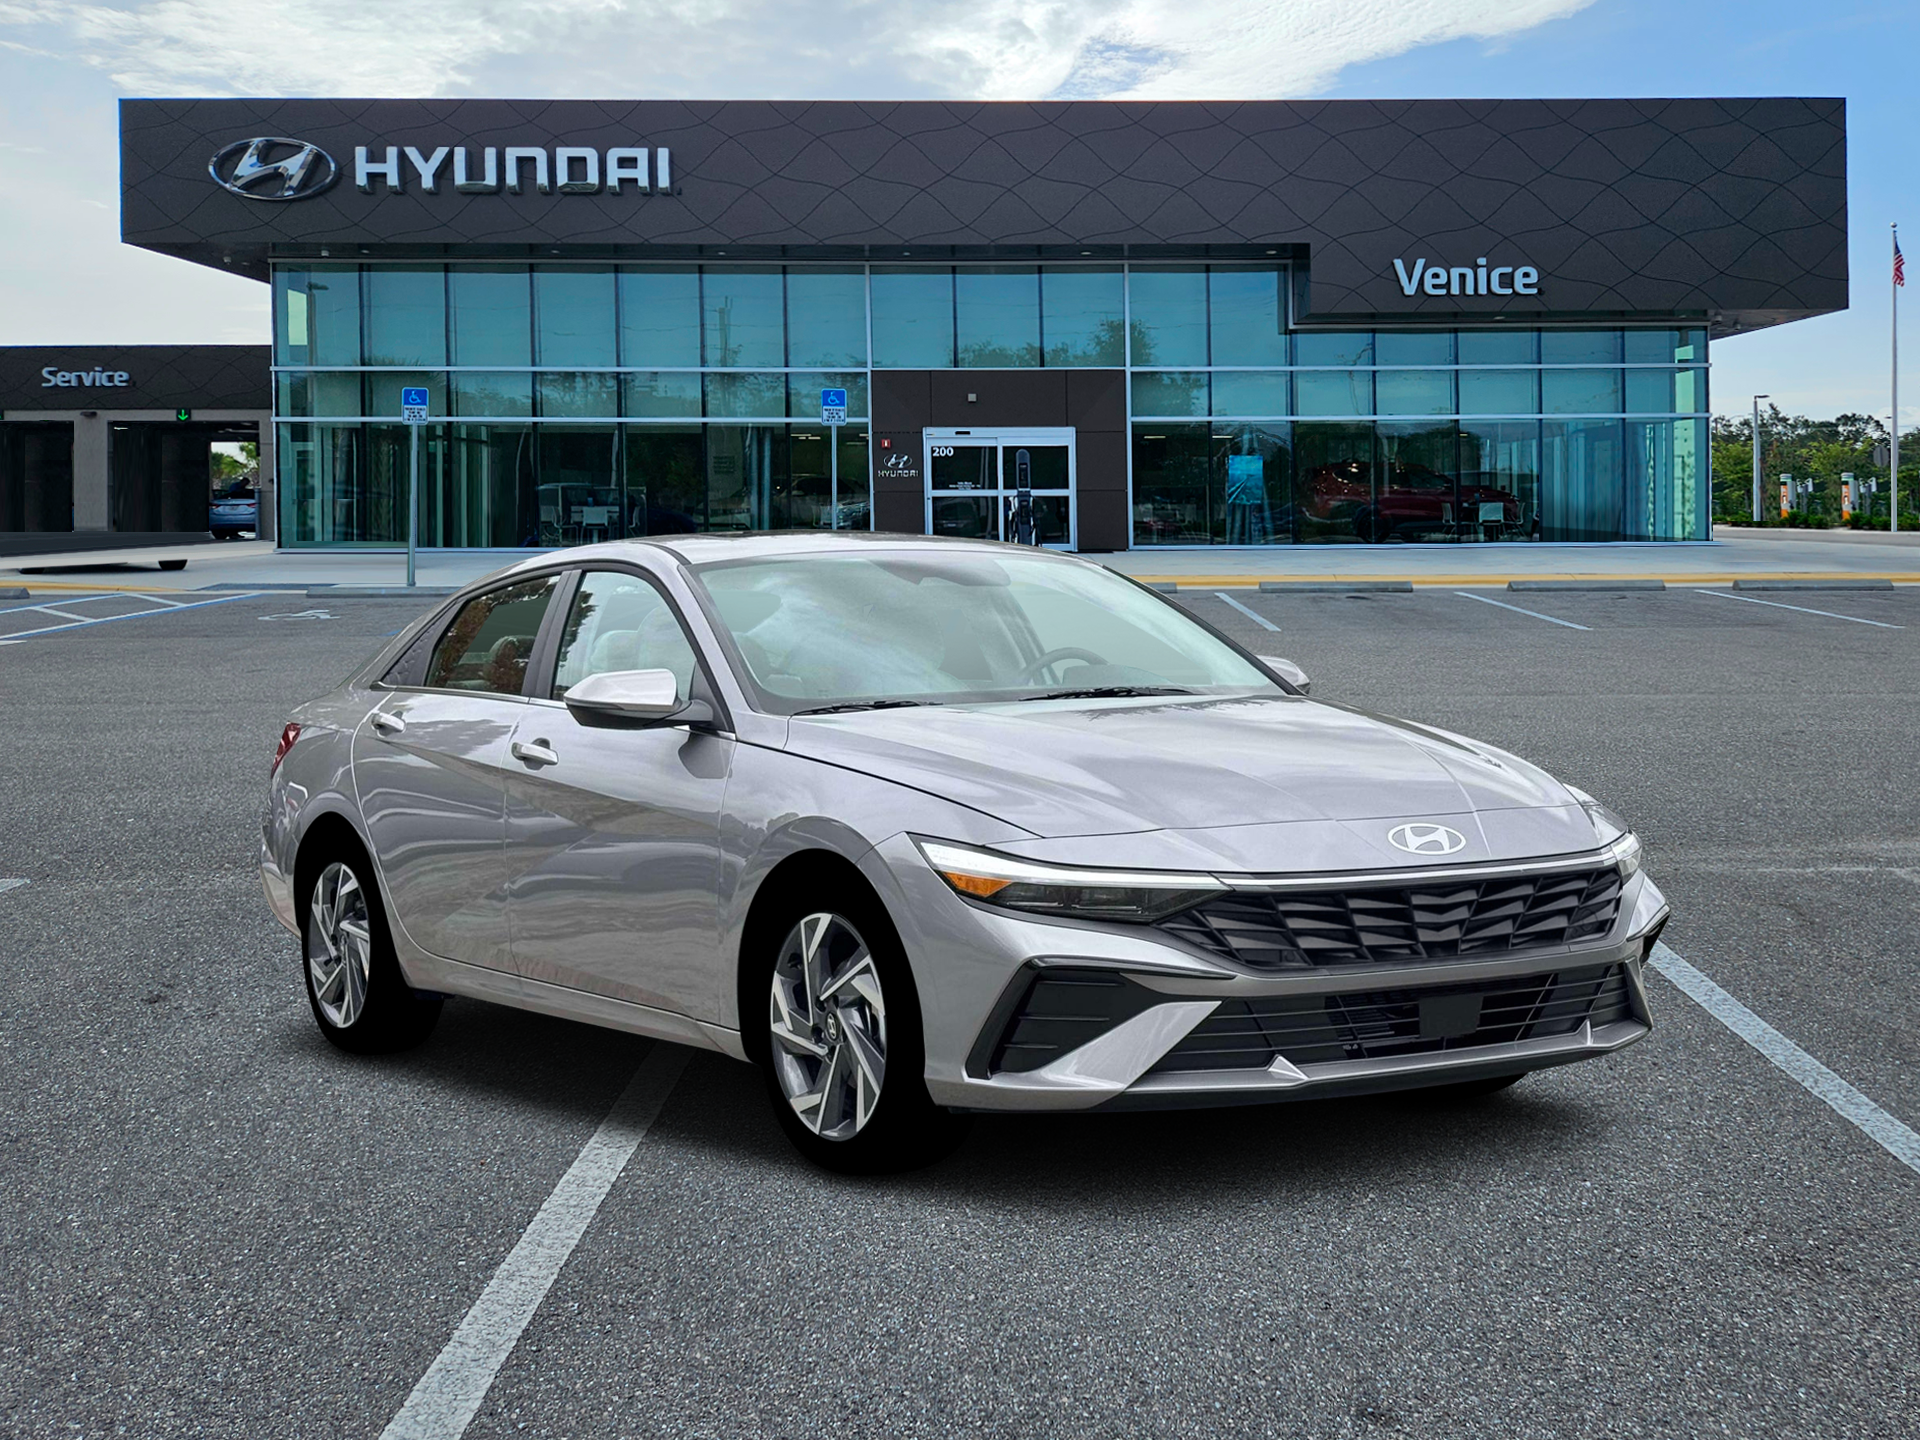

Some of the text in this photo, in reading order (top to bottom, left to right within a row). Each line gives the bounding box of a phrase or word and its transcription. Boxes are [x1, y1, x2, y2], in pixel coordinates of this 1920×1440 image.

[354, 145, 672, 193] HYUNDAI
[1392, 256, 1539, 296] Venice
[40, 366, 130, 387] Service
[932, 446, 954, 457] 200
[877, 469, 919, 478] HYUNDAI
